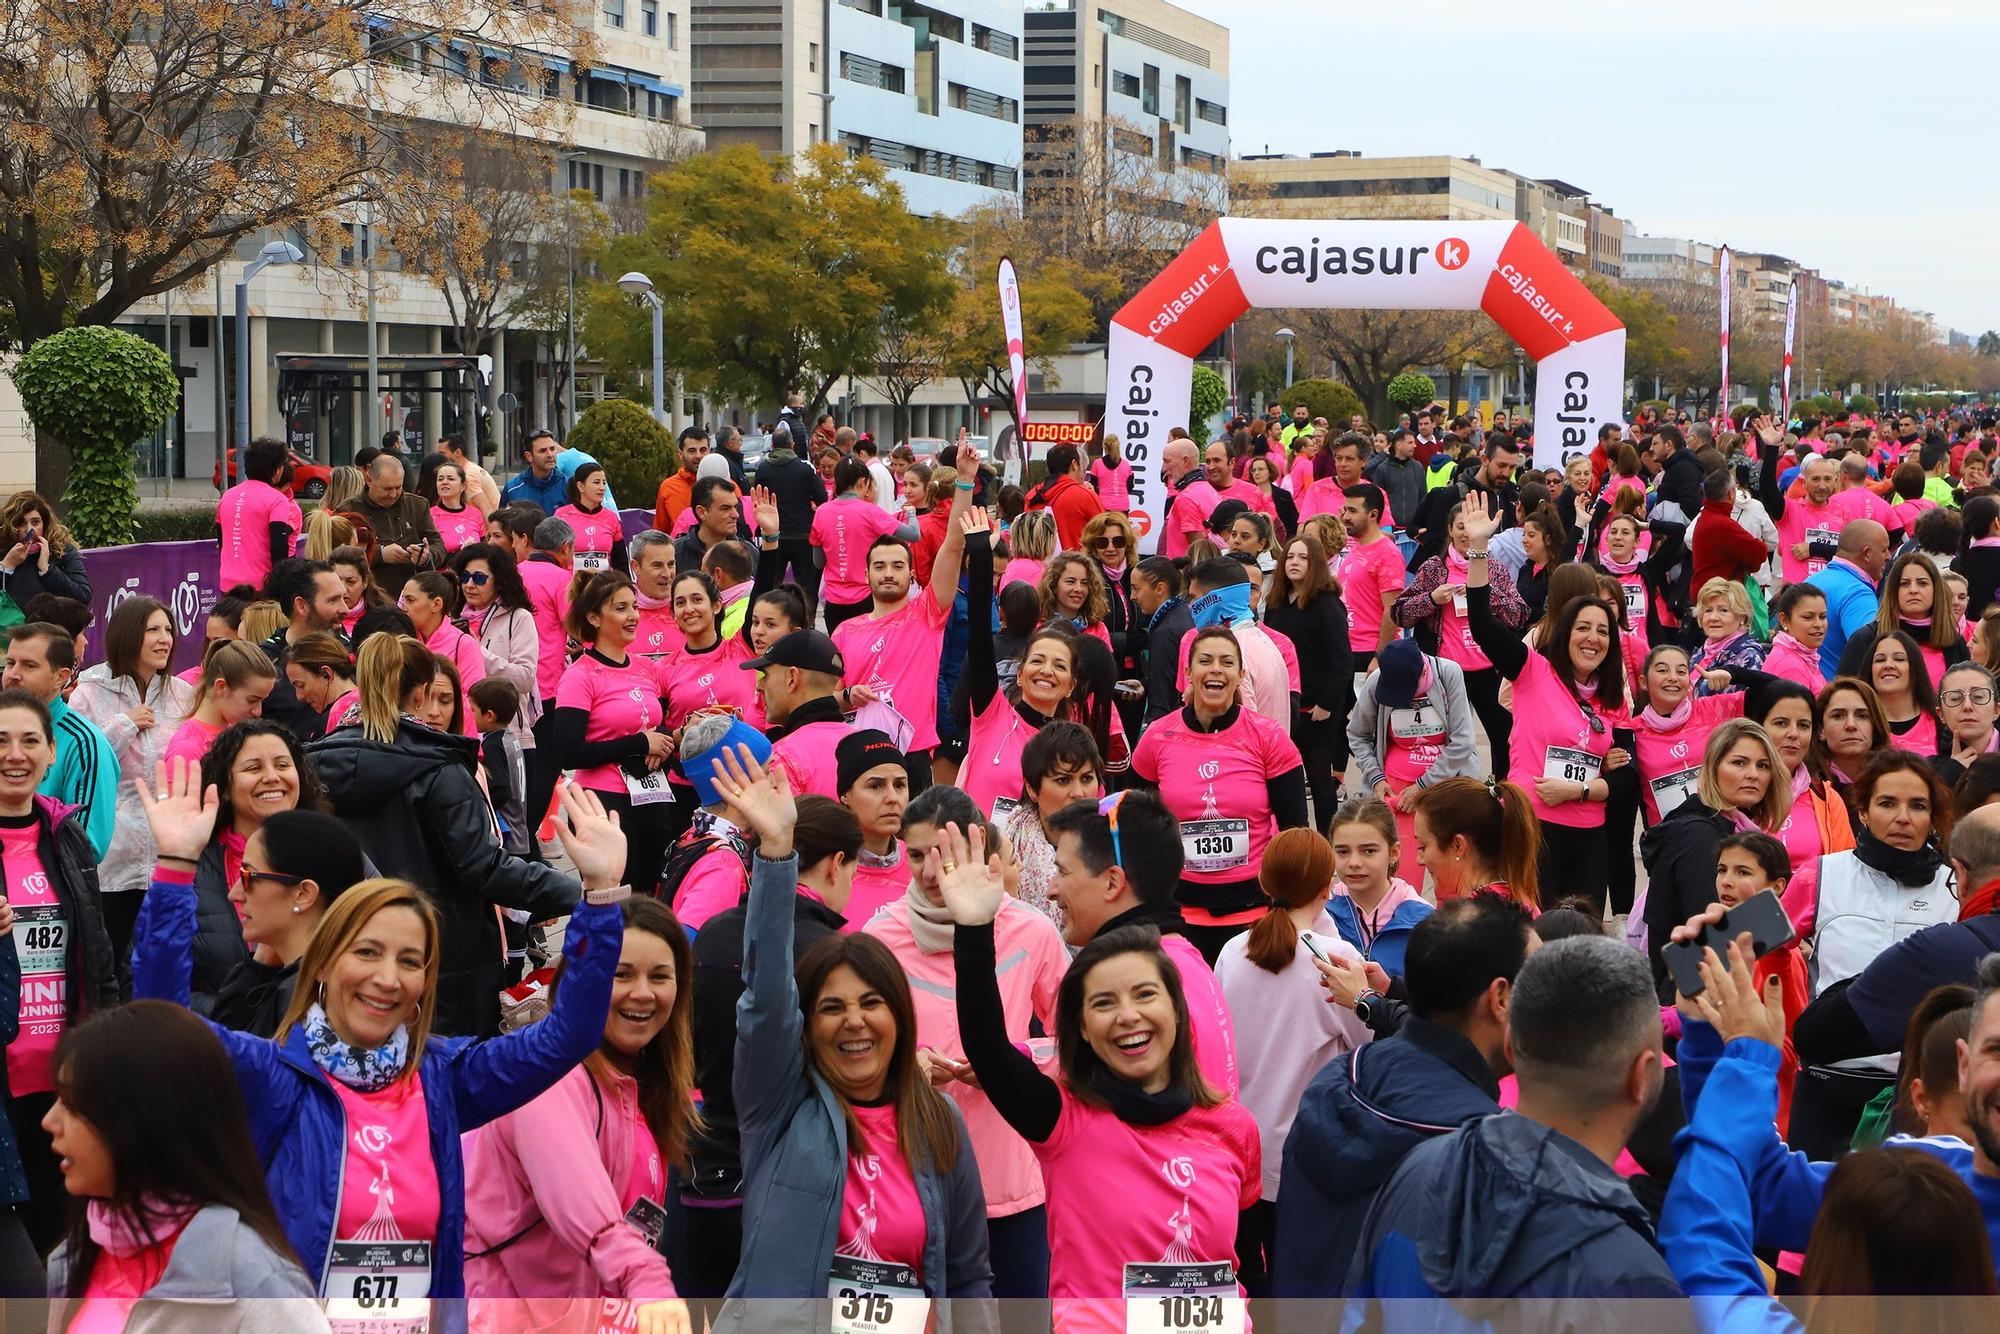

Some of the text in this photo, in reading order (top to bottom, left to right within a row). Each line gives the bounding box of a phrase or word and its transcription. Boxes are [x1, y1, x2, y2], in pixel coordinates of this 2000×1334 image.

[1256, 237, 1429, 283] cajasur
[1149, 263, 1221, 334] cajasur k
[1501, 263, 1574, 334] cajasur k
[1025, 424, 1093, 441] 00:00:00
[1122, 365, 1159, 505] cajasur
[584, 560, 600, 568] 803
[1191, 594, 1218, 615] Sevilla
[1414, 712, 1422, 724] 4
[1410, 753, 1438, 762] RUNN
[640, 775, 660, 789] 865
[1564, 764, 1586, 782] 813
[1194, 836, 1233, 855] 1330
[25, 926, 64, 949] 482
[18, 1004, 67, 1018] UNNIN
[30, 1024, 60, 1035] 2023
[852, 1265, 877, 1273] CADENA
[856, 1276, 880, 1284] ELLAS
[353, 1275, 399, 1308] 677
[839, 1288, 894, 1324] 315
[1159, 1295, 1224, 1328] 1034
